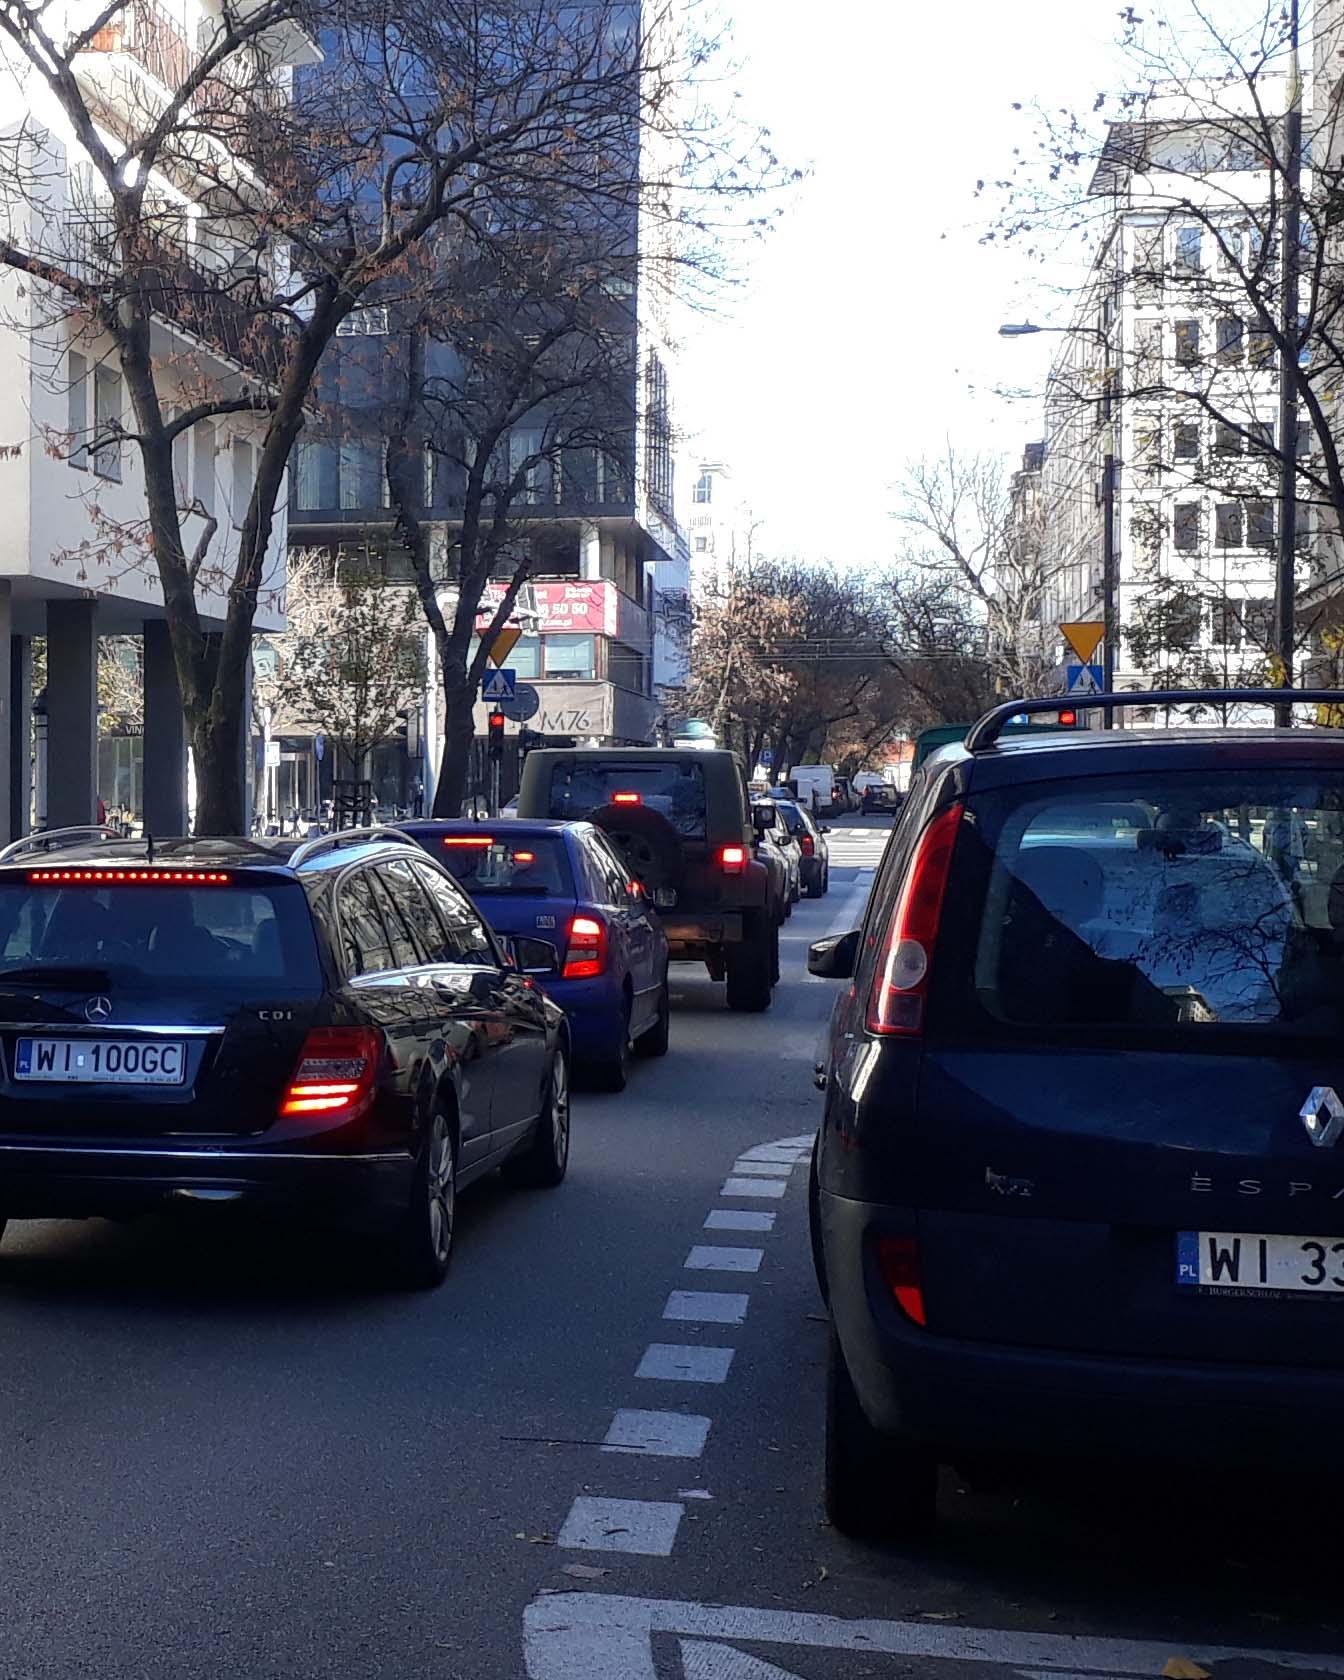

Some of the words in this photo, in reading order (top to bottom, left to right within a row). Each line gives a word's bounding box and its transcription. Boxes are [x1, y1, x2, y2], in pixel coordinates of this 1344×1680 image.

[37, 1043, 71, 1072] WI
[91, 1044, 177, 1074] 100GC
[1179, 1264, 1197, 1278] PL
[1209, 1237, 1267, 1283] WI
